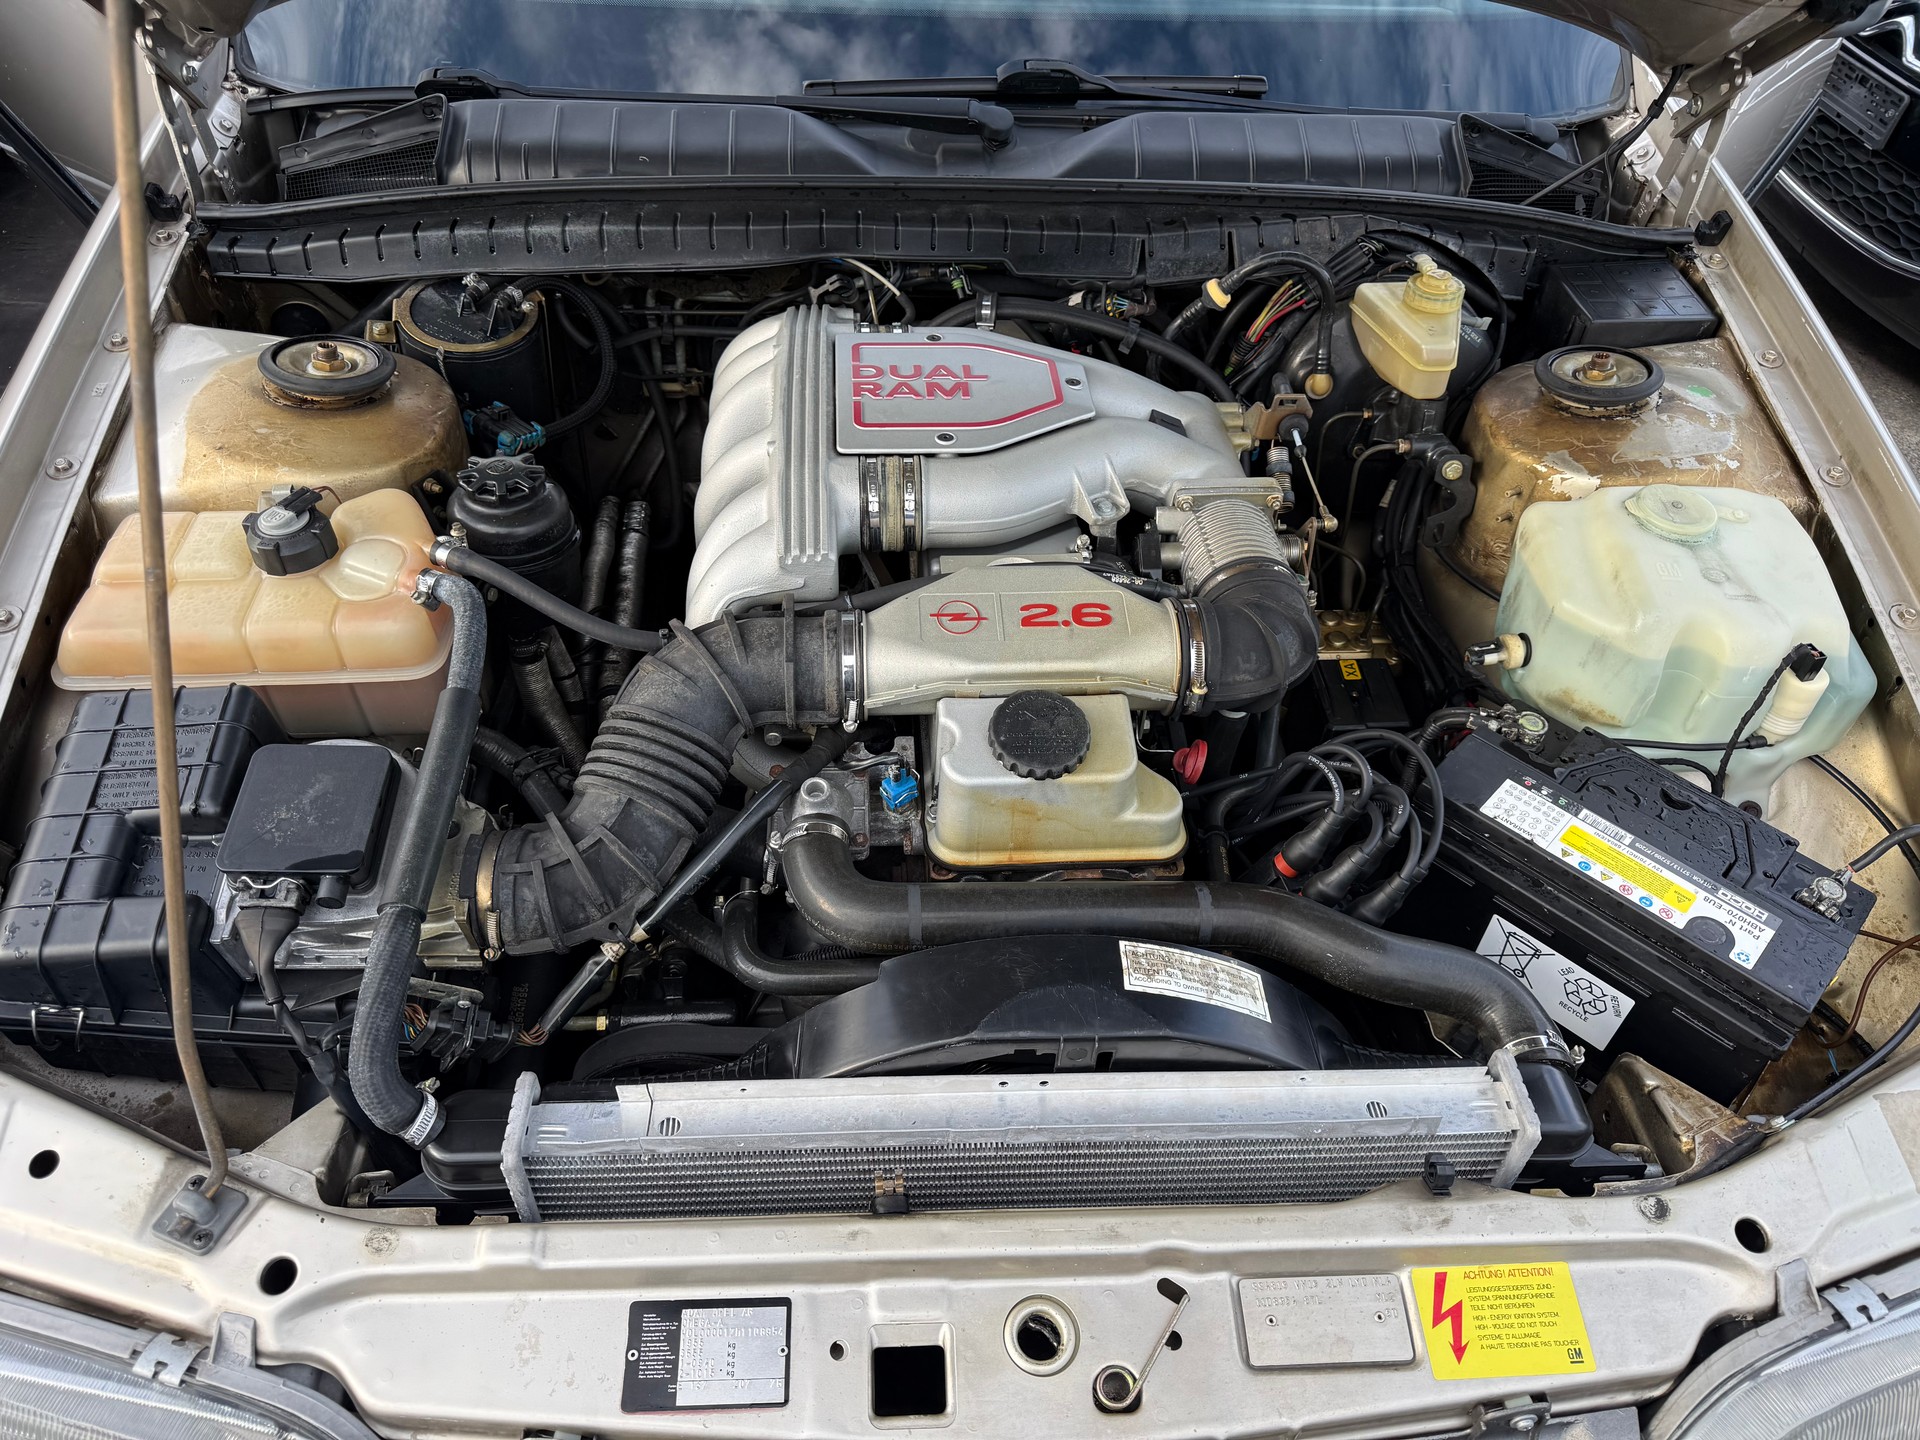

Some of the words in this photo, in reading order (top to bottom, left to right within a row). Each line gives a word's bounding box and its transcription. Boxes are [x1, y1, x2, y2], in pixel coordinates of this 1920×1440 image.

[852, 364, 988, 382] DUAL
[852, 381, 972, 401] RAM
[1019, 602, 1114, 628] 2.6
[1344, 663, 1358, 678] XA
[1702, 894, 1767, 934] ABH070-EU8
[1737, 924, 1761, 941] Part
[1557, 966, 1576, 979] LEAD
[1134, 976, 1172, 985] ACCORDING
[1558, 1000, 1589, 1023] RECYCLE
[1611, 995, 1623, 1020] RETURN
[1463, 1268, 1506, 1280] ACHTUNG!
[1508, 1267, 1555, 1277] ATTENTION!
[1504, 1302, 1535, 1310] BERÜHREN
[1491, 1313, 1512, 1321] ENERGY
[1475, 1323, 1488, 1331] HIGH
[1493, 1322, 1516, 1330] VOLTAGE
[1526, 1321, 1538, 1329] NOT
[727, 1341, 737, 1350] kg
[1486, 1342, 1505, 1350] HAUTE
[1506, 1341, 1530, 1349] TENSION
[1540, 1340, 1552, 1348] PAS
[1554, 1339, 1579, 1347] TOUCHER
[727, 1350, 737, 1359] kg
[1568, 1347, 1584, 1360] GM
[727, 1359, 736, 1369] kg
[726, 1369, 736, 1378] kg
